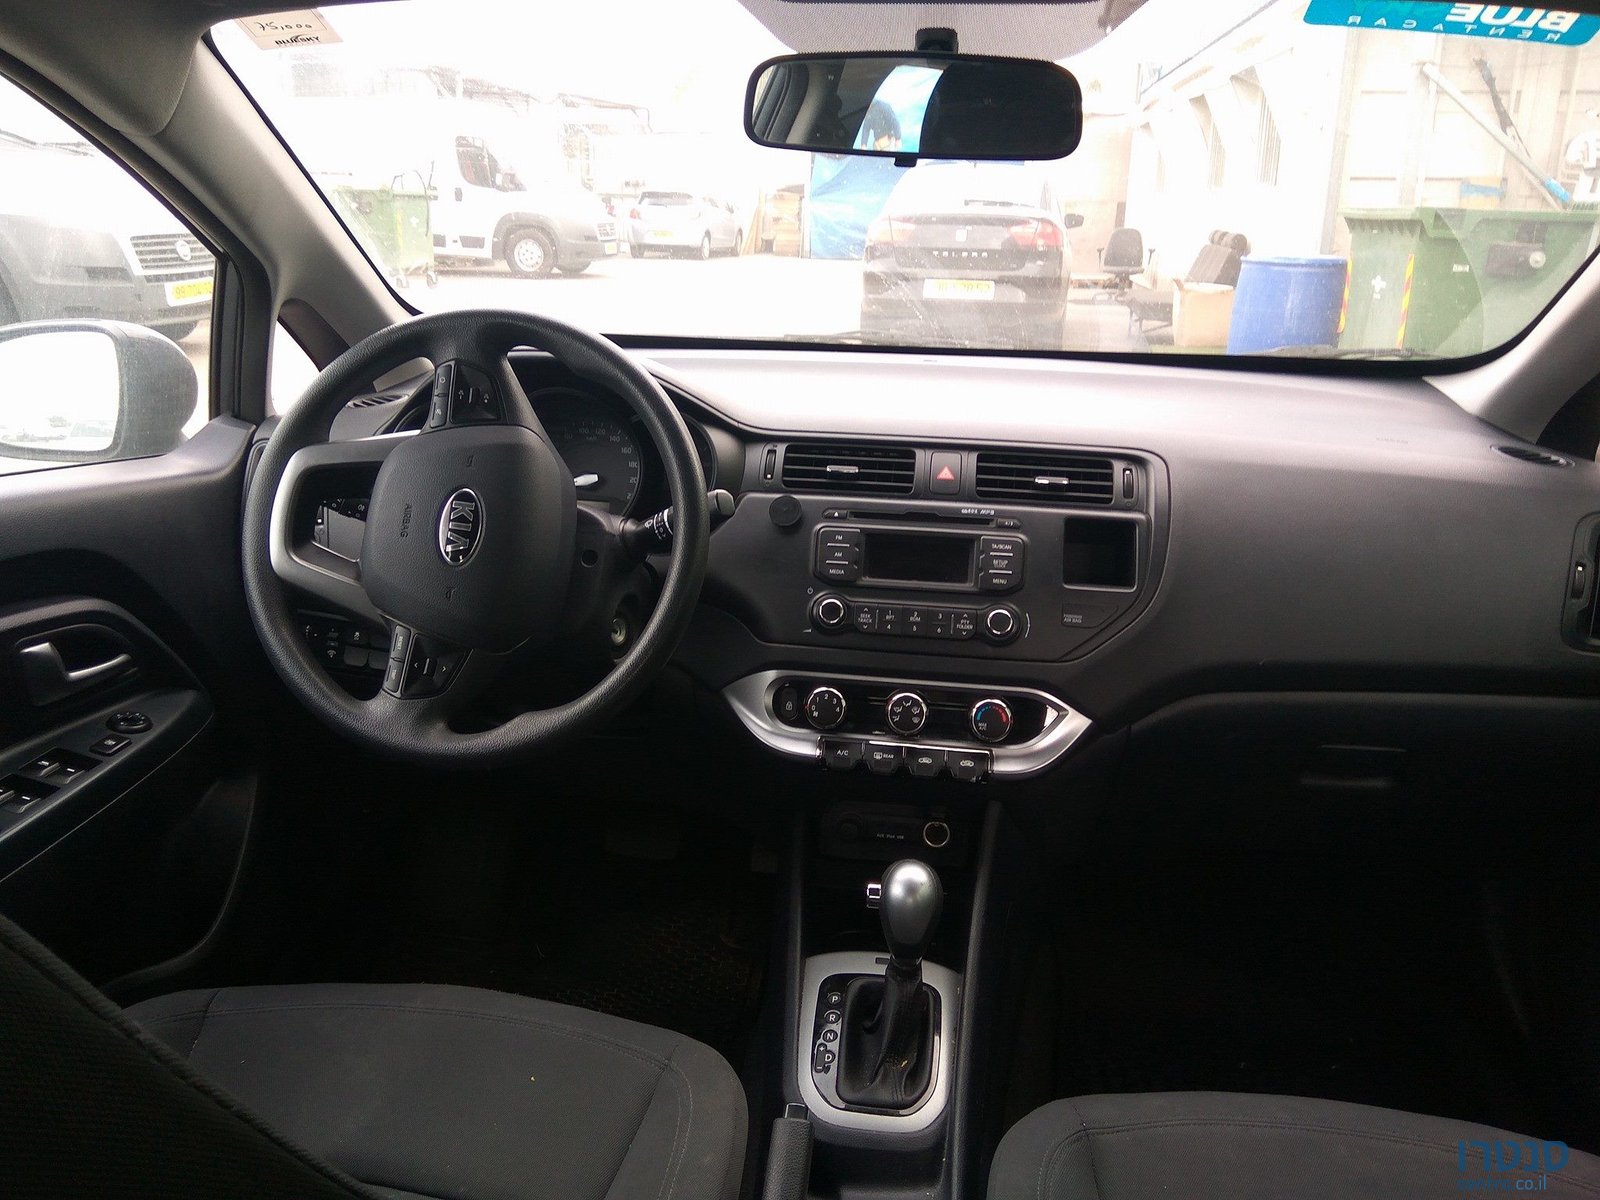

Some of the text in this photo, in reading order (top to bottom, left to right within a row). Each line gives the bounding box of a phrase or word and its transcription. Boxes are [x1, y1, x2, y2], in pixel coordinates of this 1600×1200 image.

[621, 447, 632, 455] 160
[446, 501, 475, 552] KIA
[832, 697, 837, 705] 3
[836, 749, 849, 757] A/C
[831, 995, 839, 1003] P
[829, 1014, 836, 1022] R
[826, 1032, 834, 1040] N
[825, 1053, 833, 1062] D
